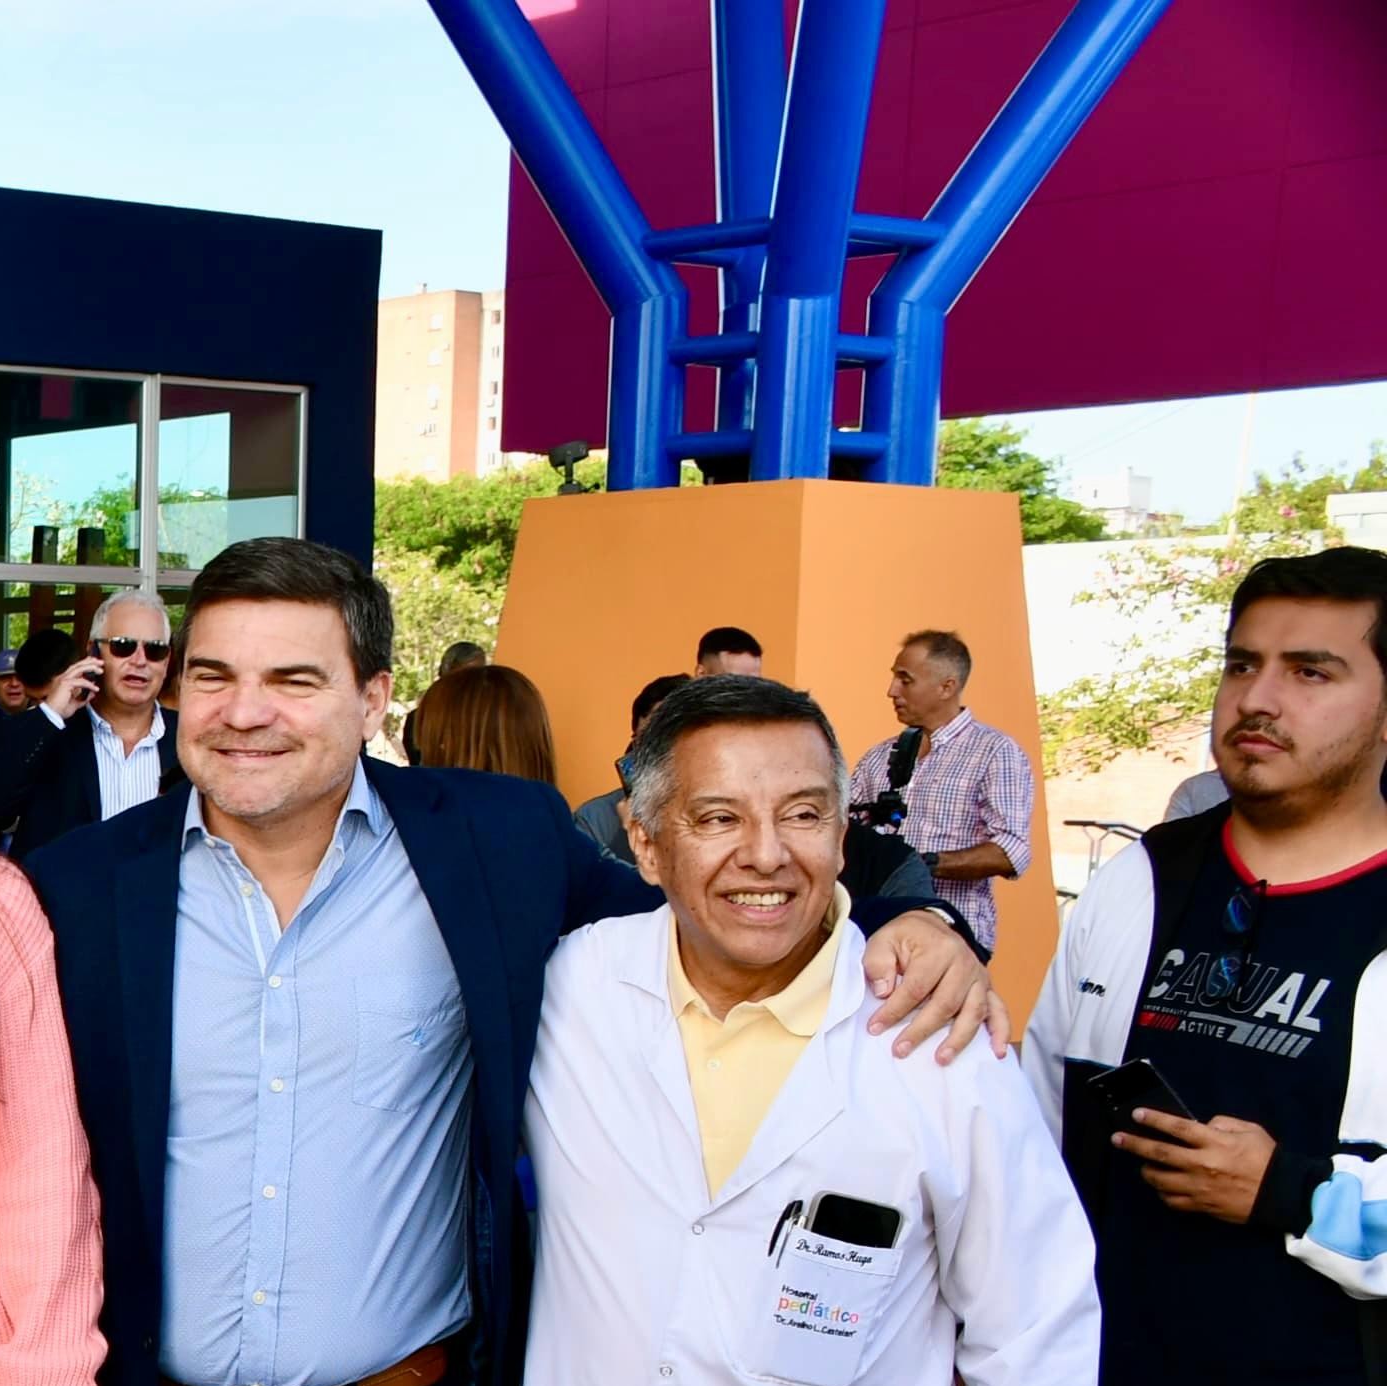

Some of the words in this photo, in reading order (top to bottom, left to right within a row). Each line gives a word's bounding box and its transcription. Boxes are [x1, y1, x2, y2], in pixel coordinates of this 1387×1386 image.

[1147, 948, 1332, 1033] CASUAL
[1177, 1020, 1226, 1038] ACTIVE
[812, 1243, 845, 1260] Ramos
[845, 1250, 873, 1267] Hugo
[781, 1284, 819, 1301] Hospital
[778, 1298, 859, 1324] pediátrico
